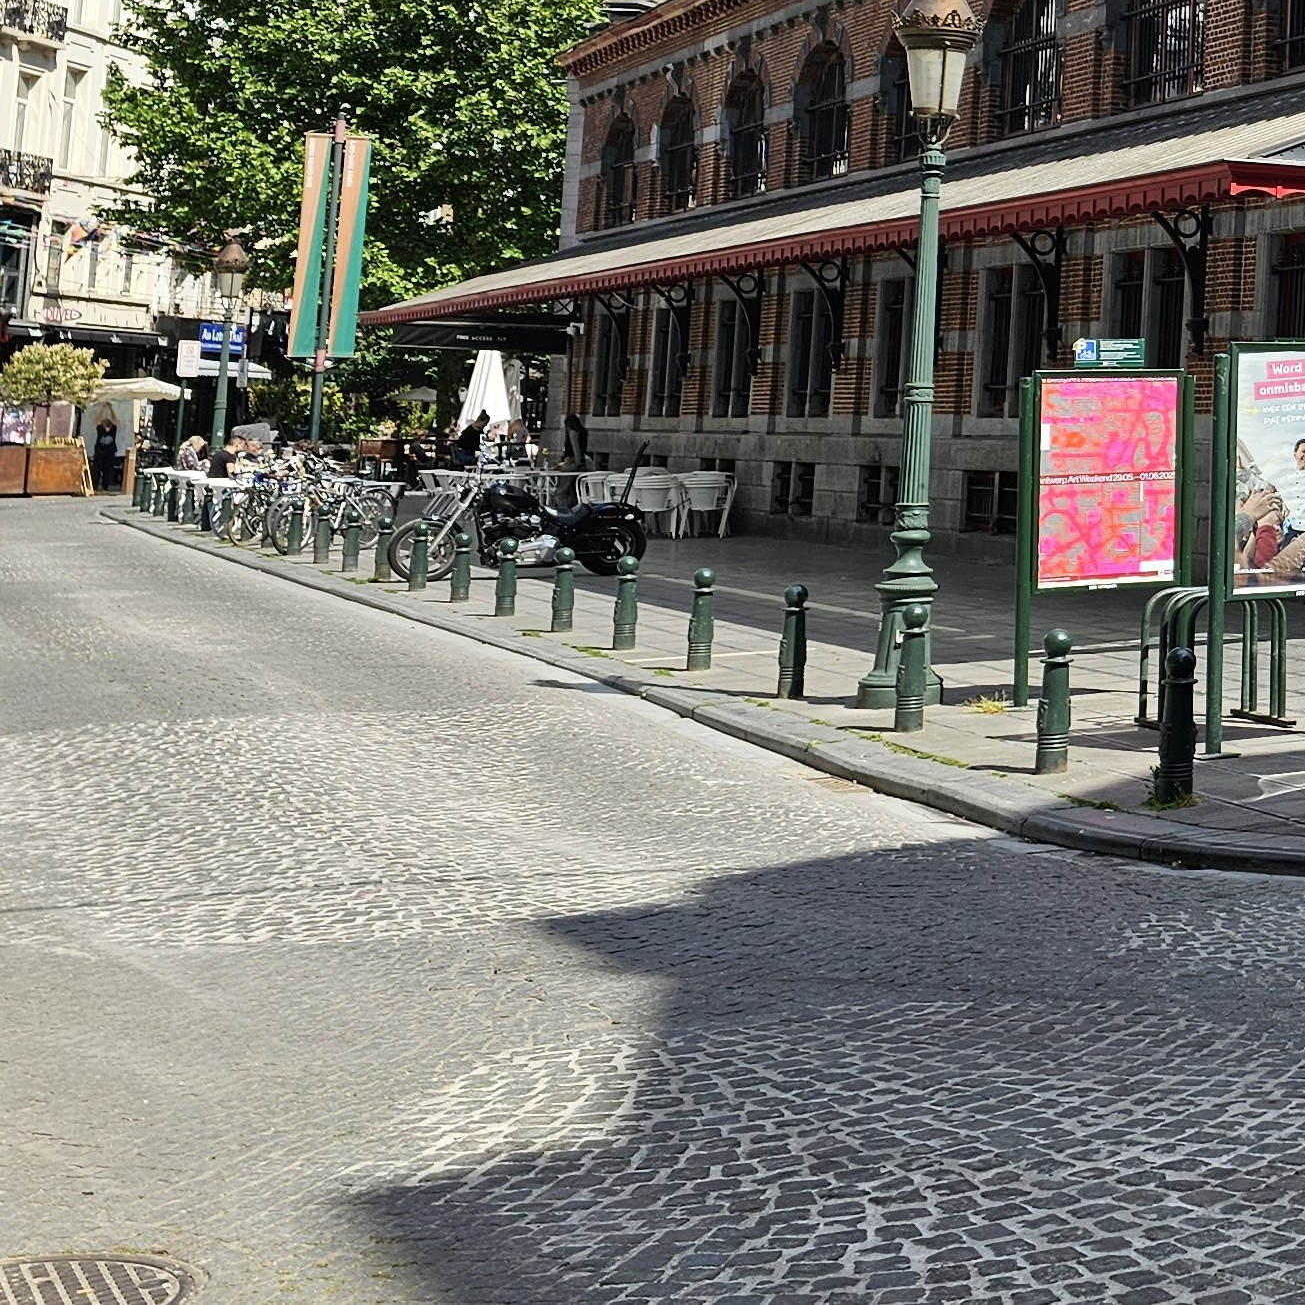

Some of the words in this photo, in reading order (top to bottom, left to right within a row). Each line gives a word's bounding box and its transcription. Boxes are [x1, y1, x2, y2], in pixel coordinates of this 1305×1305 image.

[1271, 361, 1303, 375] Word
[1040, 476, 1067, 486] ntwerp
[1067, 475, 1080, 484] Art
[1080, 473, 1113, 484] Weekend
